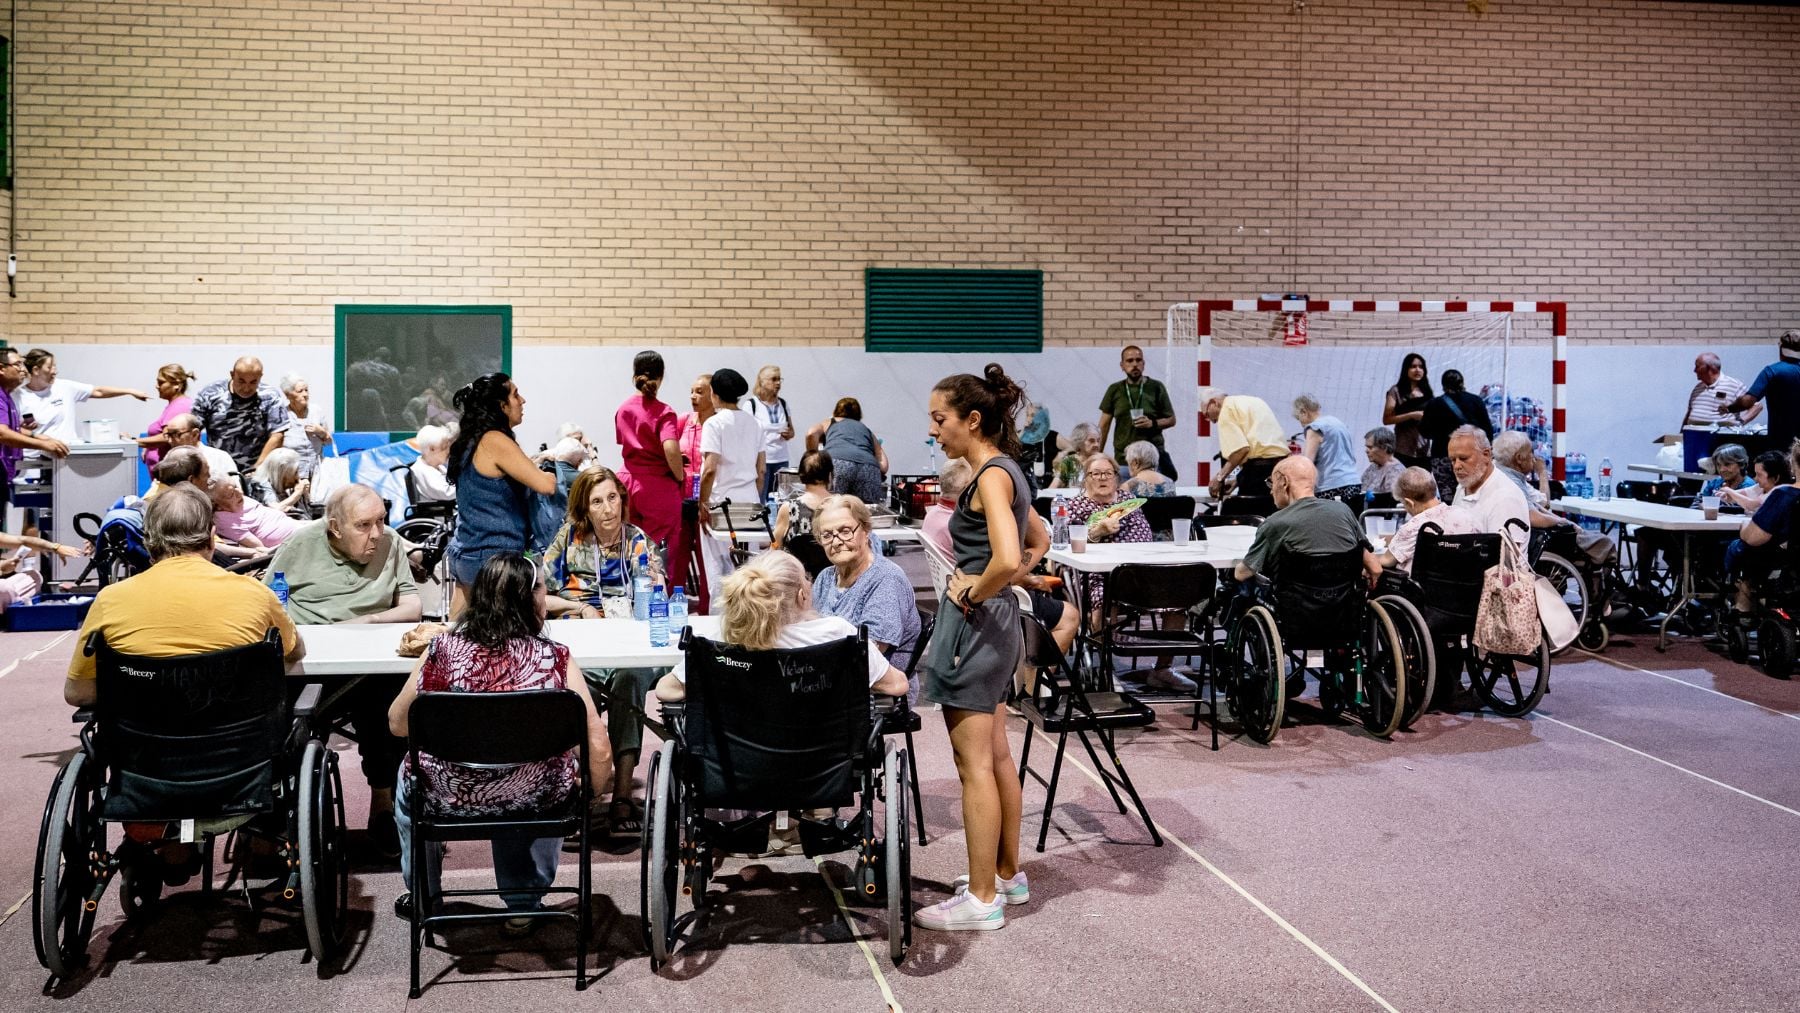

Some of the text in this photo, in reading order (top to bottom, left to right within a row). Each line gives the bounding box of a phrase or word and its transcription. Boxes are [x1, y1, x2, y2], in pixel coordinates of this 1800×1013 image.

[726, 656, 752, 671] Breezy
[777, 655, 816, 677] Victoria
[128, 667, 155, 680] Breezy
